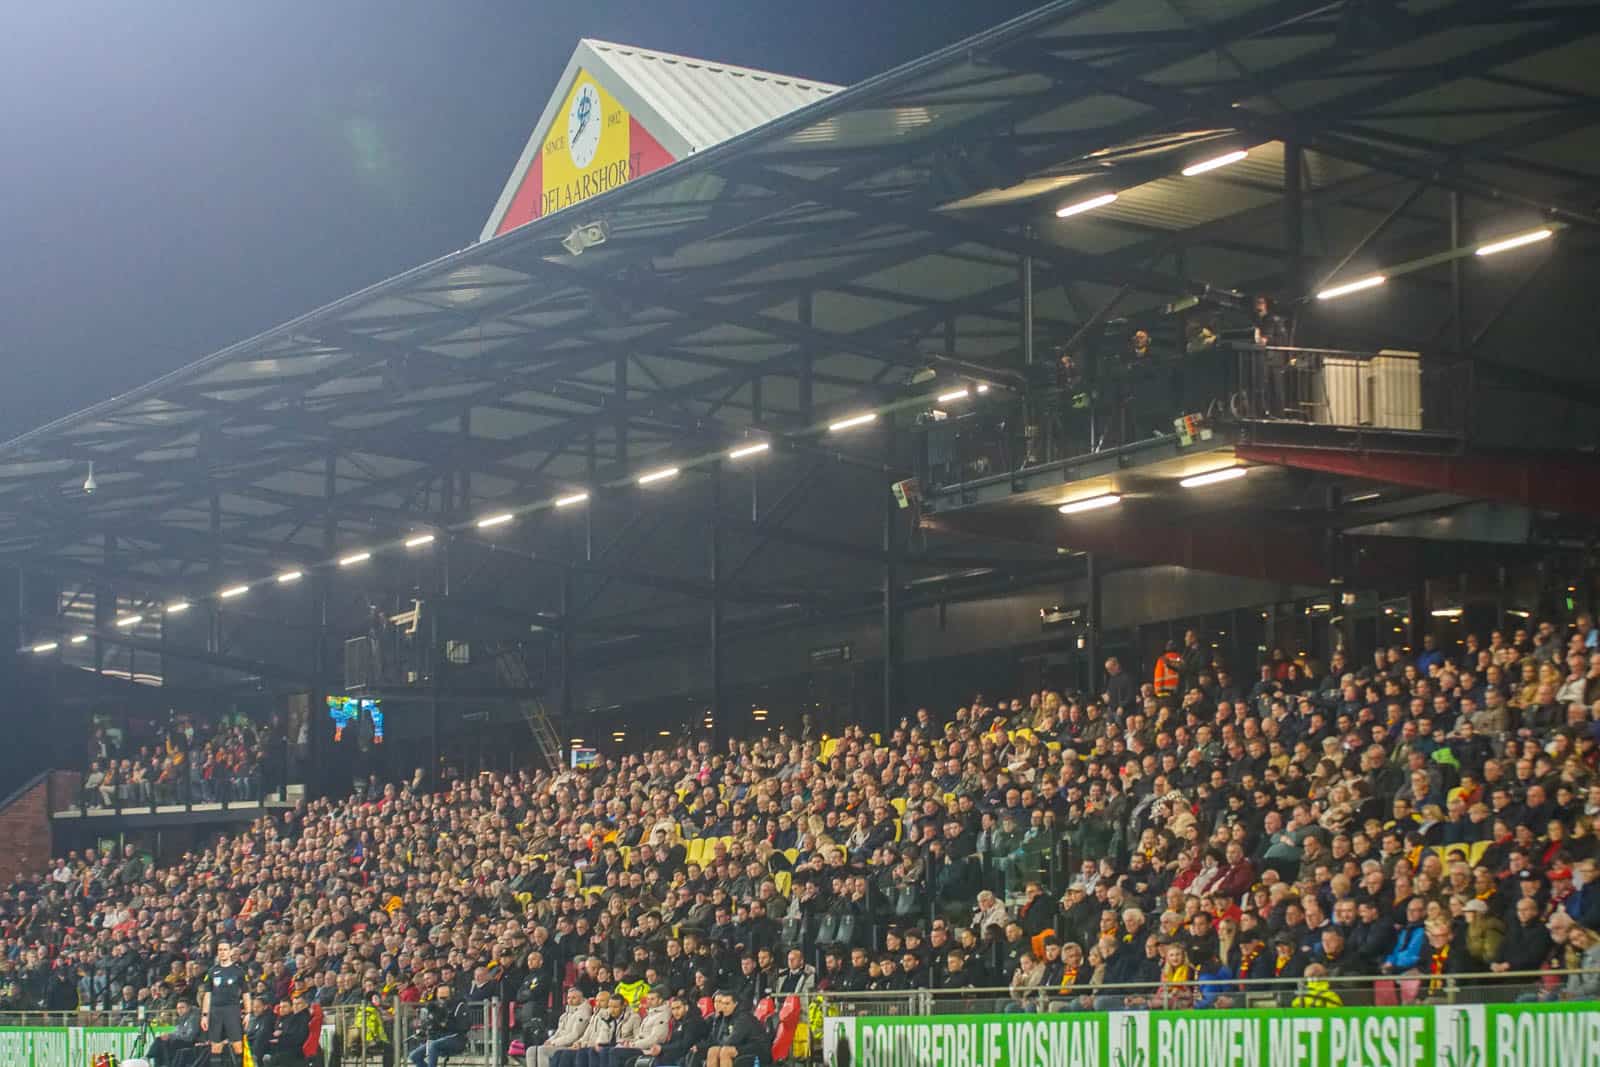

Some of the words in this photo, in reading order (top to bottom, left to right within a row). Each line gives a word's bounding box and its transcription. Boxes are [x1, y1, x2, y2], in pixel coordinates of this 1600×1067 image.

[545, 136, 565, 154] SINCE
[862, 1022, 1002, 1067] BOUWBEDRIJF
[1007, 1020, 1100, 1067] VOSMAN
[1158, 1017, 1260, 1067] BOUWEN
[1269, 1017, 1322, 1067] MET
[1330, 1015, 1424, 1067] PASSIE
